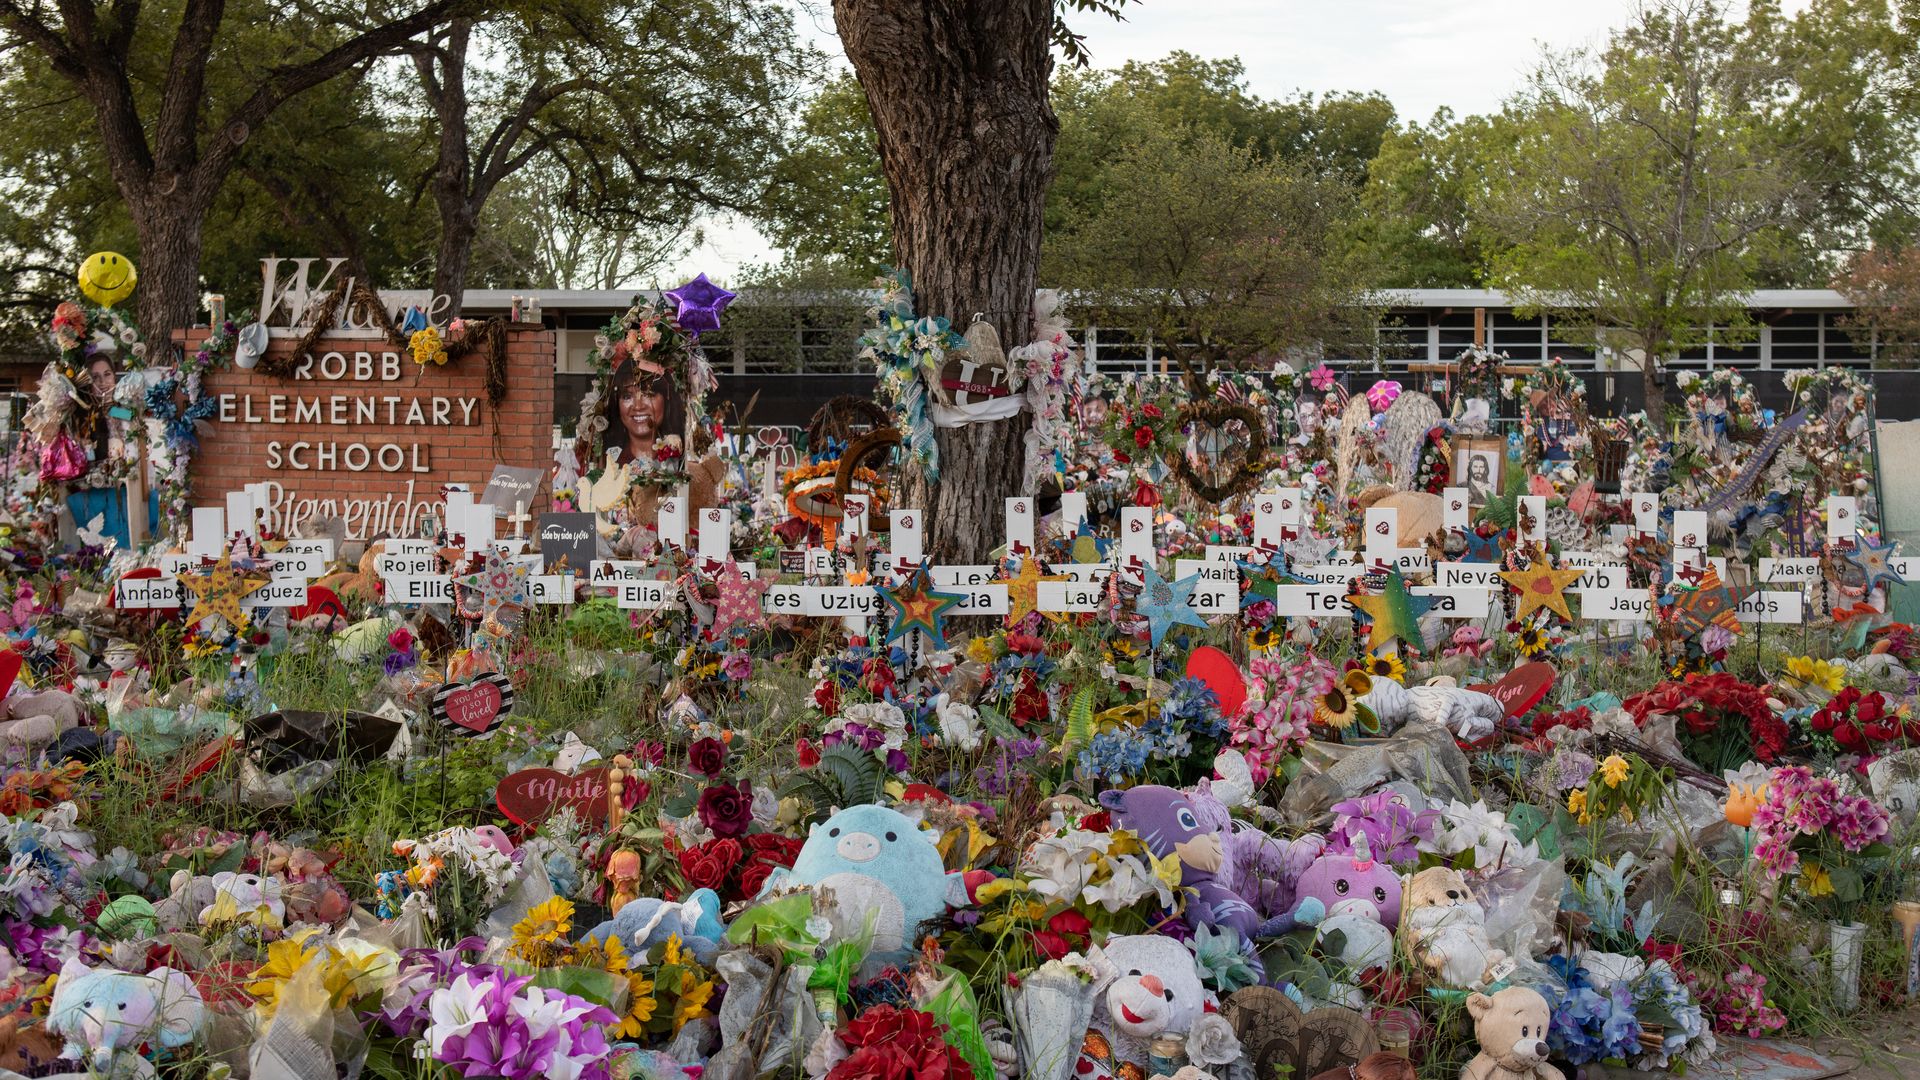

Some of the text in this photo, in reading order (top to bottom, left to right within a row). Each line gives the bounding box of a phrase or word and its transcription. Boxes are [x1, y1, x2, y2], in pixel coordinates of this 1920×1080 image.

[296, 352, 400, 380] ROBB
[219, 394, 476, 425] ELEMENTARY
[266, 441, 429, 473] SCHOOL
[541, 528, 589, 549] side by side you
[384, 560, 436, 575] Rojeli
[1446, 569, 1502, 585] Neva
[821, 593, 885, 612] Uziya
[453, 687, 490, 706] YOU ARE
[469, 701, 481, 709] SO
[459, 696, 493, 723] loved
